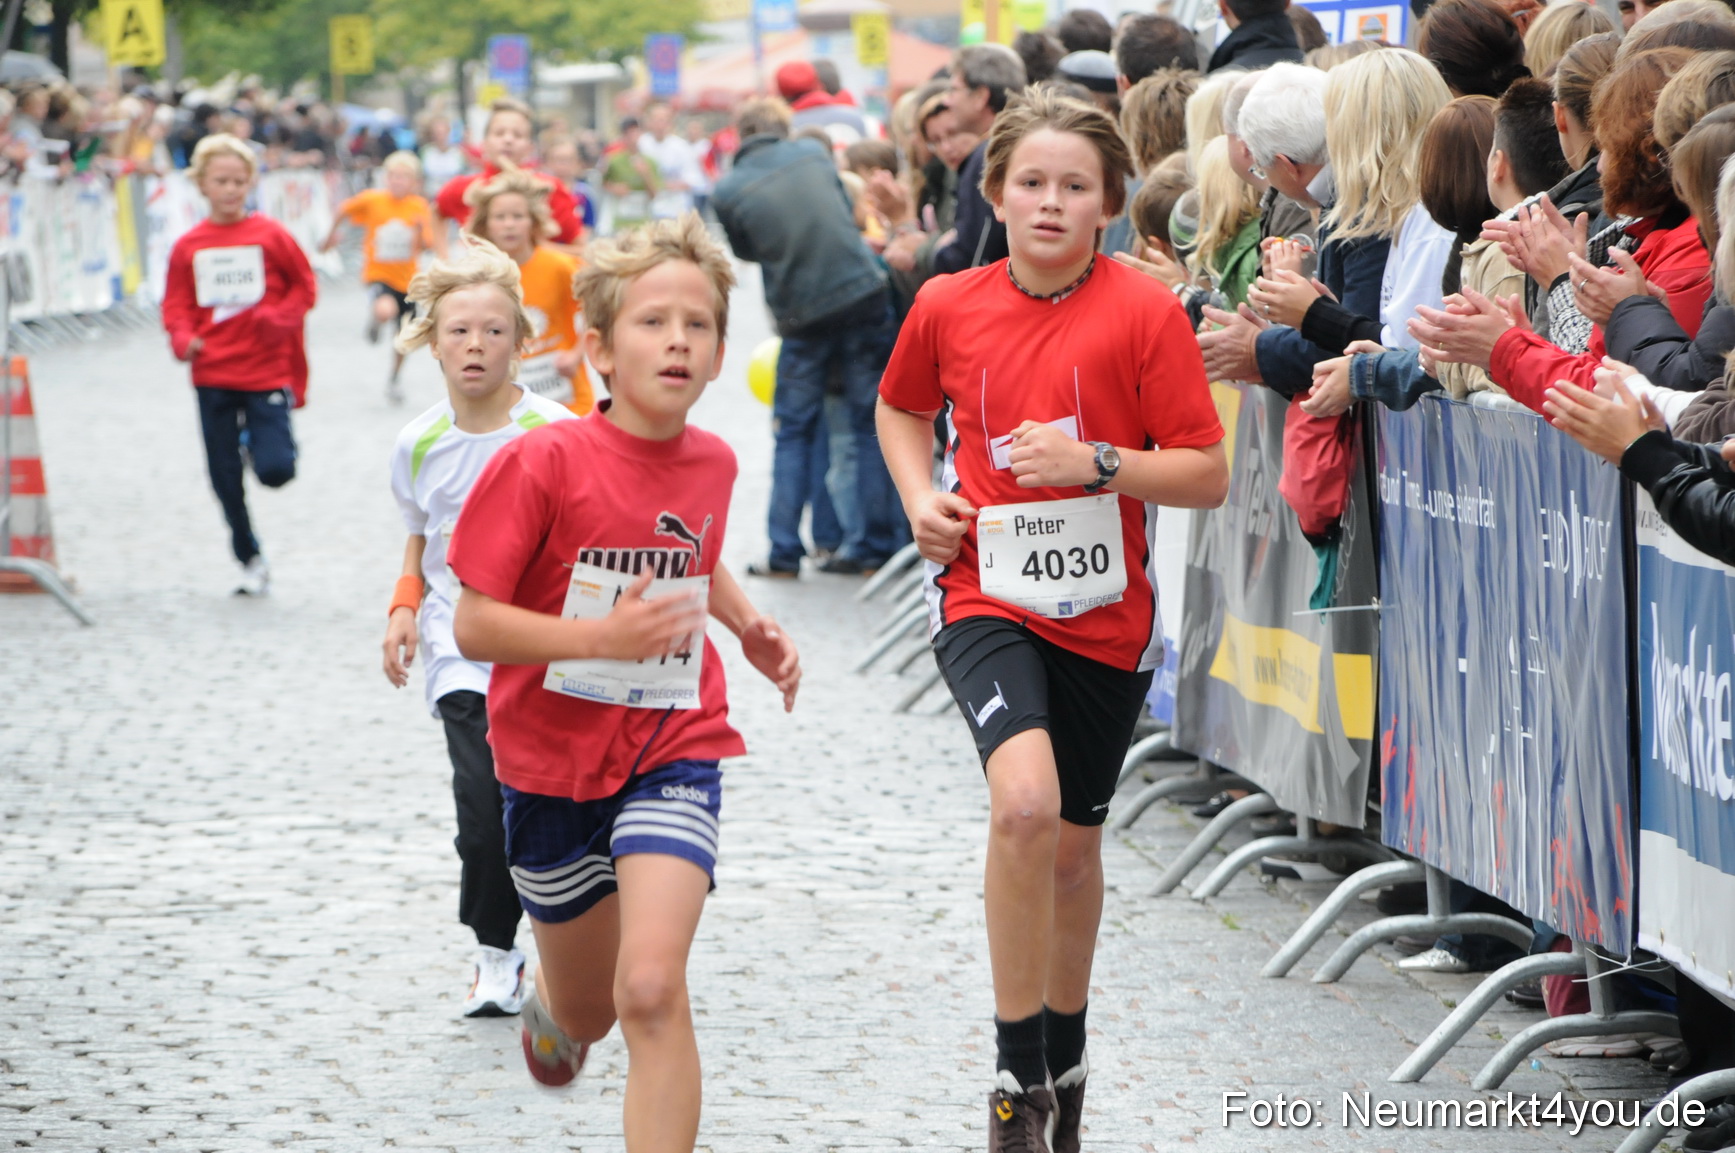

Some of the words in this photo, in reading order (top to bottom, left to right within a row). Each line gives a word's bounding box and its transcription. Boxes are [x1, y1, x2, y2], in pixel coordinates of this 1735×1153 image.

[115, 6, 150, 44] A
[1014, 514, 1065, 537] Peter
[985, 552, 994, 569] J
[1021, 543, 1110, 582] 4030
[645, 687, 696, 700] PFLEIDERER
[661, 783, 710, 806] adidas
